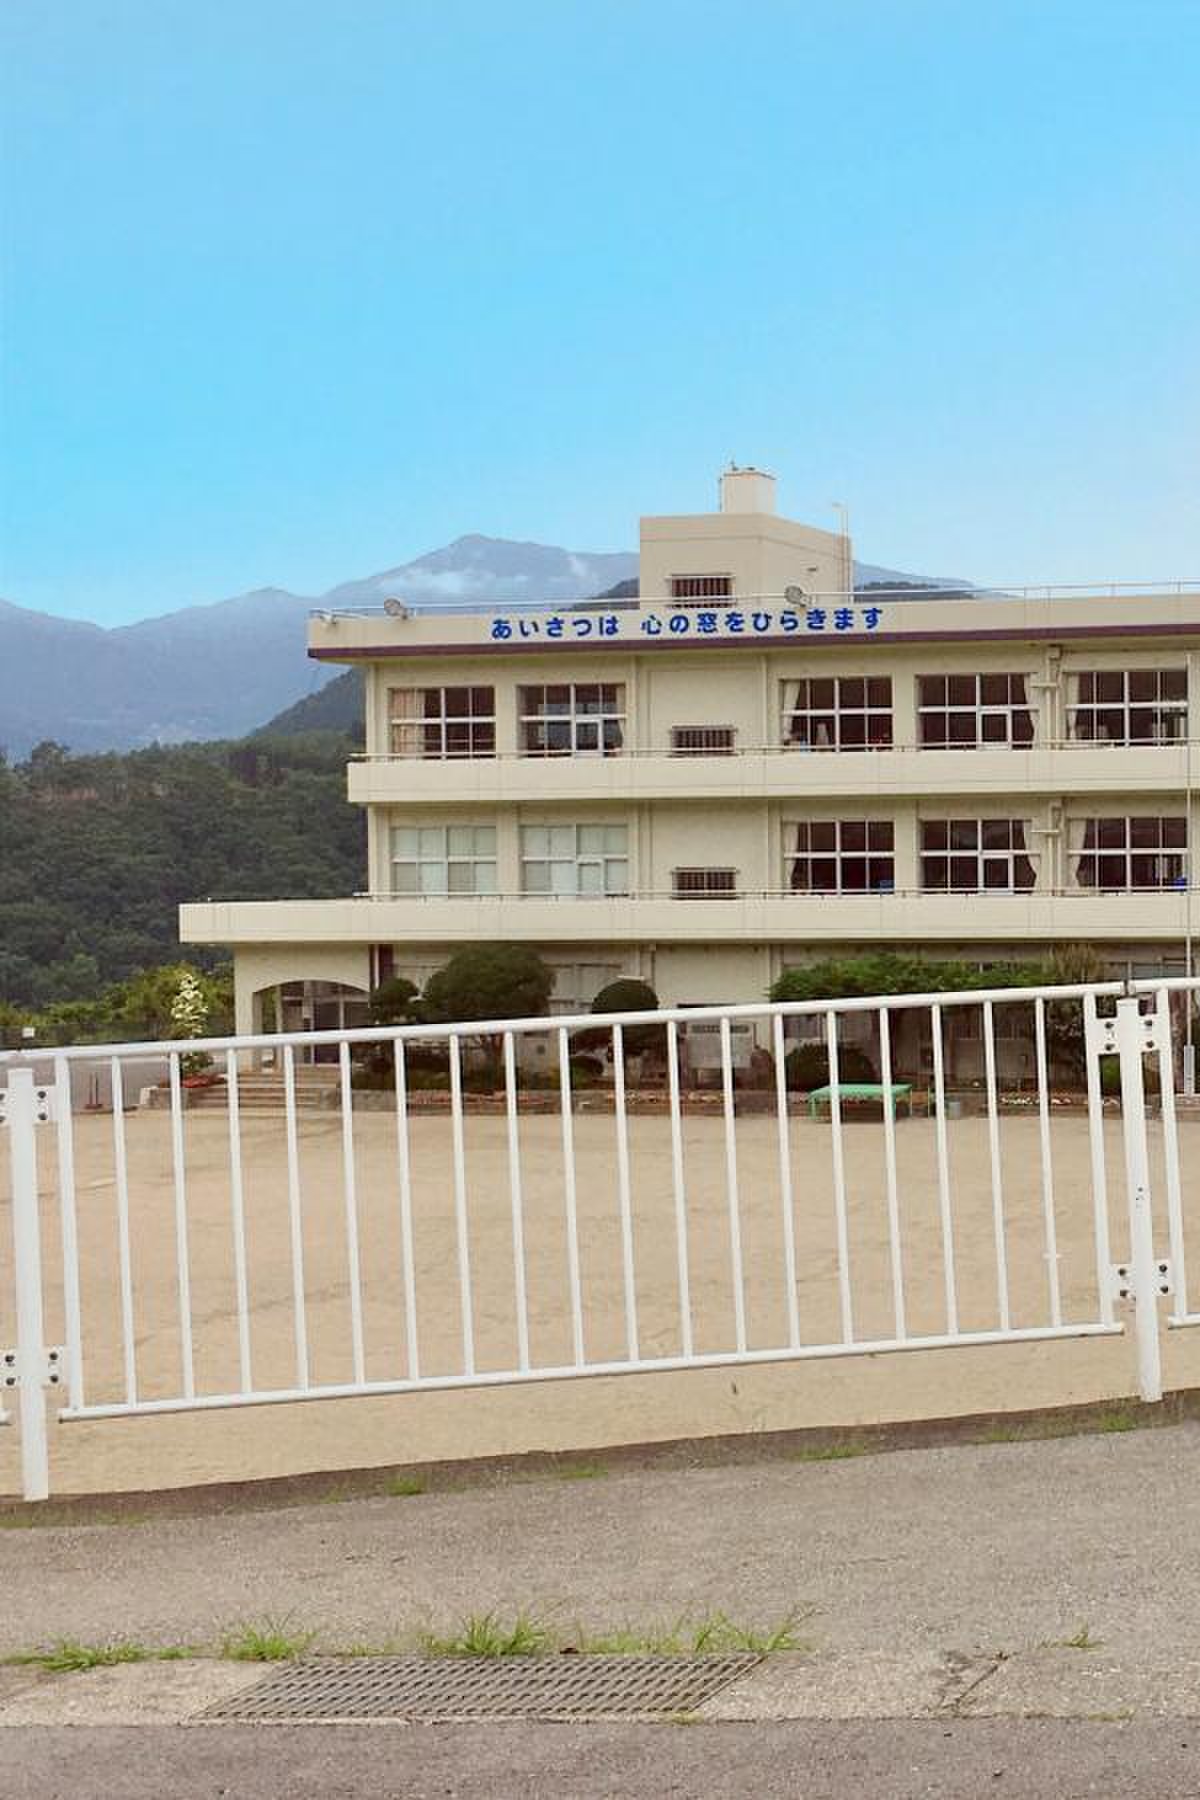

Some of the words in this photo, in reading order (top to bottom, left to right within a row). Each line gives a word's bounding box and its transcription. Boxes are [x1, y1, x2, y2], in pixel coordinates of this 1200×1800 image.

[491, 616, 619, 640] あいさつは
[640, 607, 883, 635] 心の窓をひらきます
